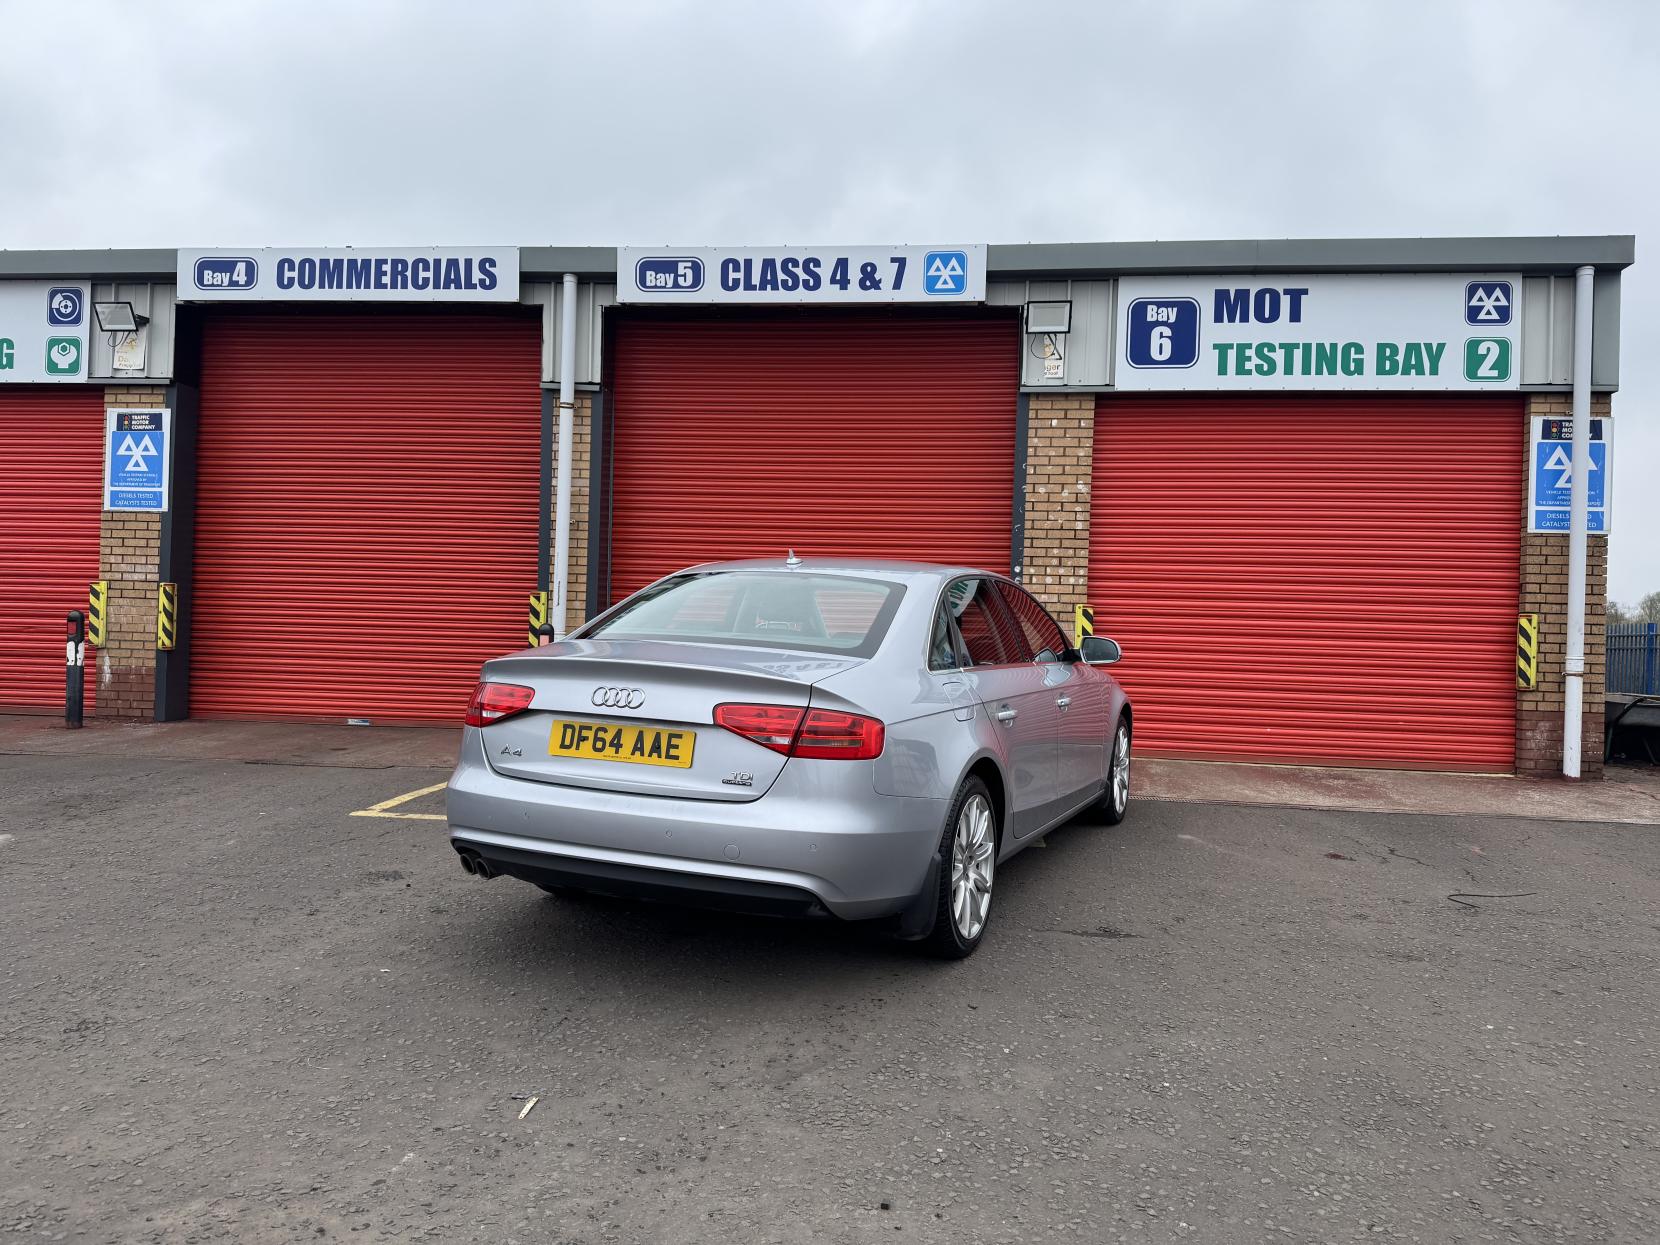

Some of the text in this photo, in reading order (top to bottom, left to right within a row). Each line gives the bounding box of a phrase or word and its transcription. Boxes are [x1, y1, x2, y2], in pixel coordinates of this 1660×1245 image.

[203, 262, 247, 286] Bay 4
[276, 257, 498, 291] COMMERCIALS
[645, 261, 693, 288] Bay 5
[720, 256, 908, 292] CLASS 4 & 7
[1146, 304, 1178, 323] Bay
[1213, 287, 1309, 324] MOT
[1150, 325, 1173, 362] 6
[1212, 340, 1501, 378] TESTING BAY 2
[500, 743, 523, 757] A4
[560, 724, 684, 761] DF64 AAE
[731, 771, 753, 782] TDI
